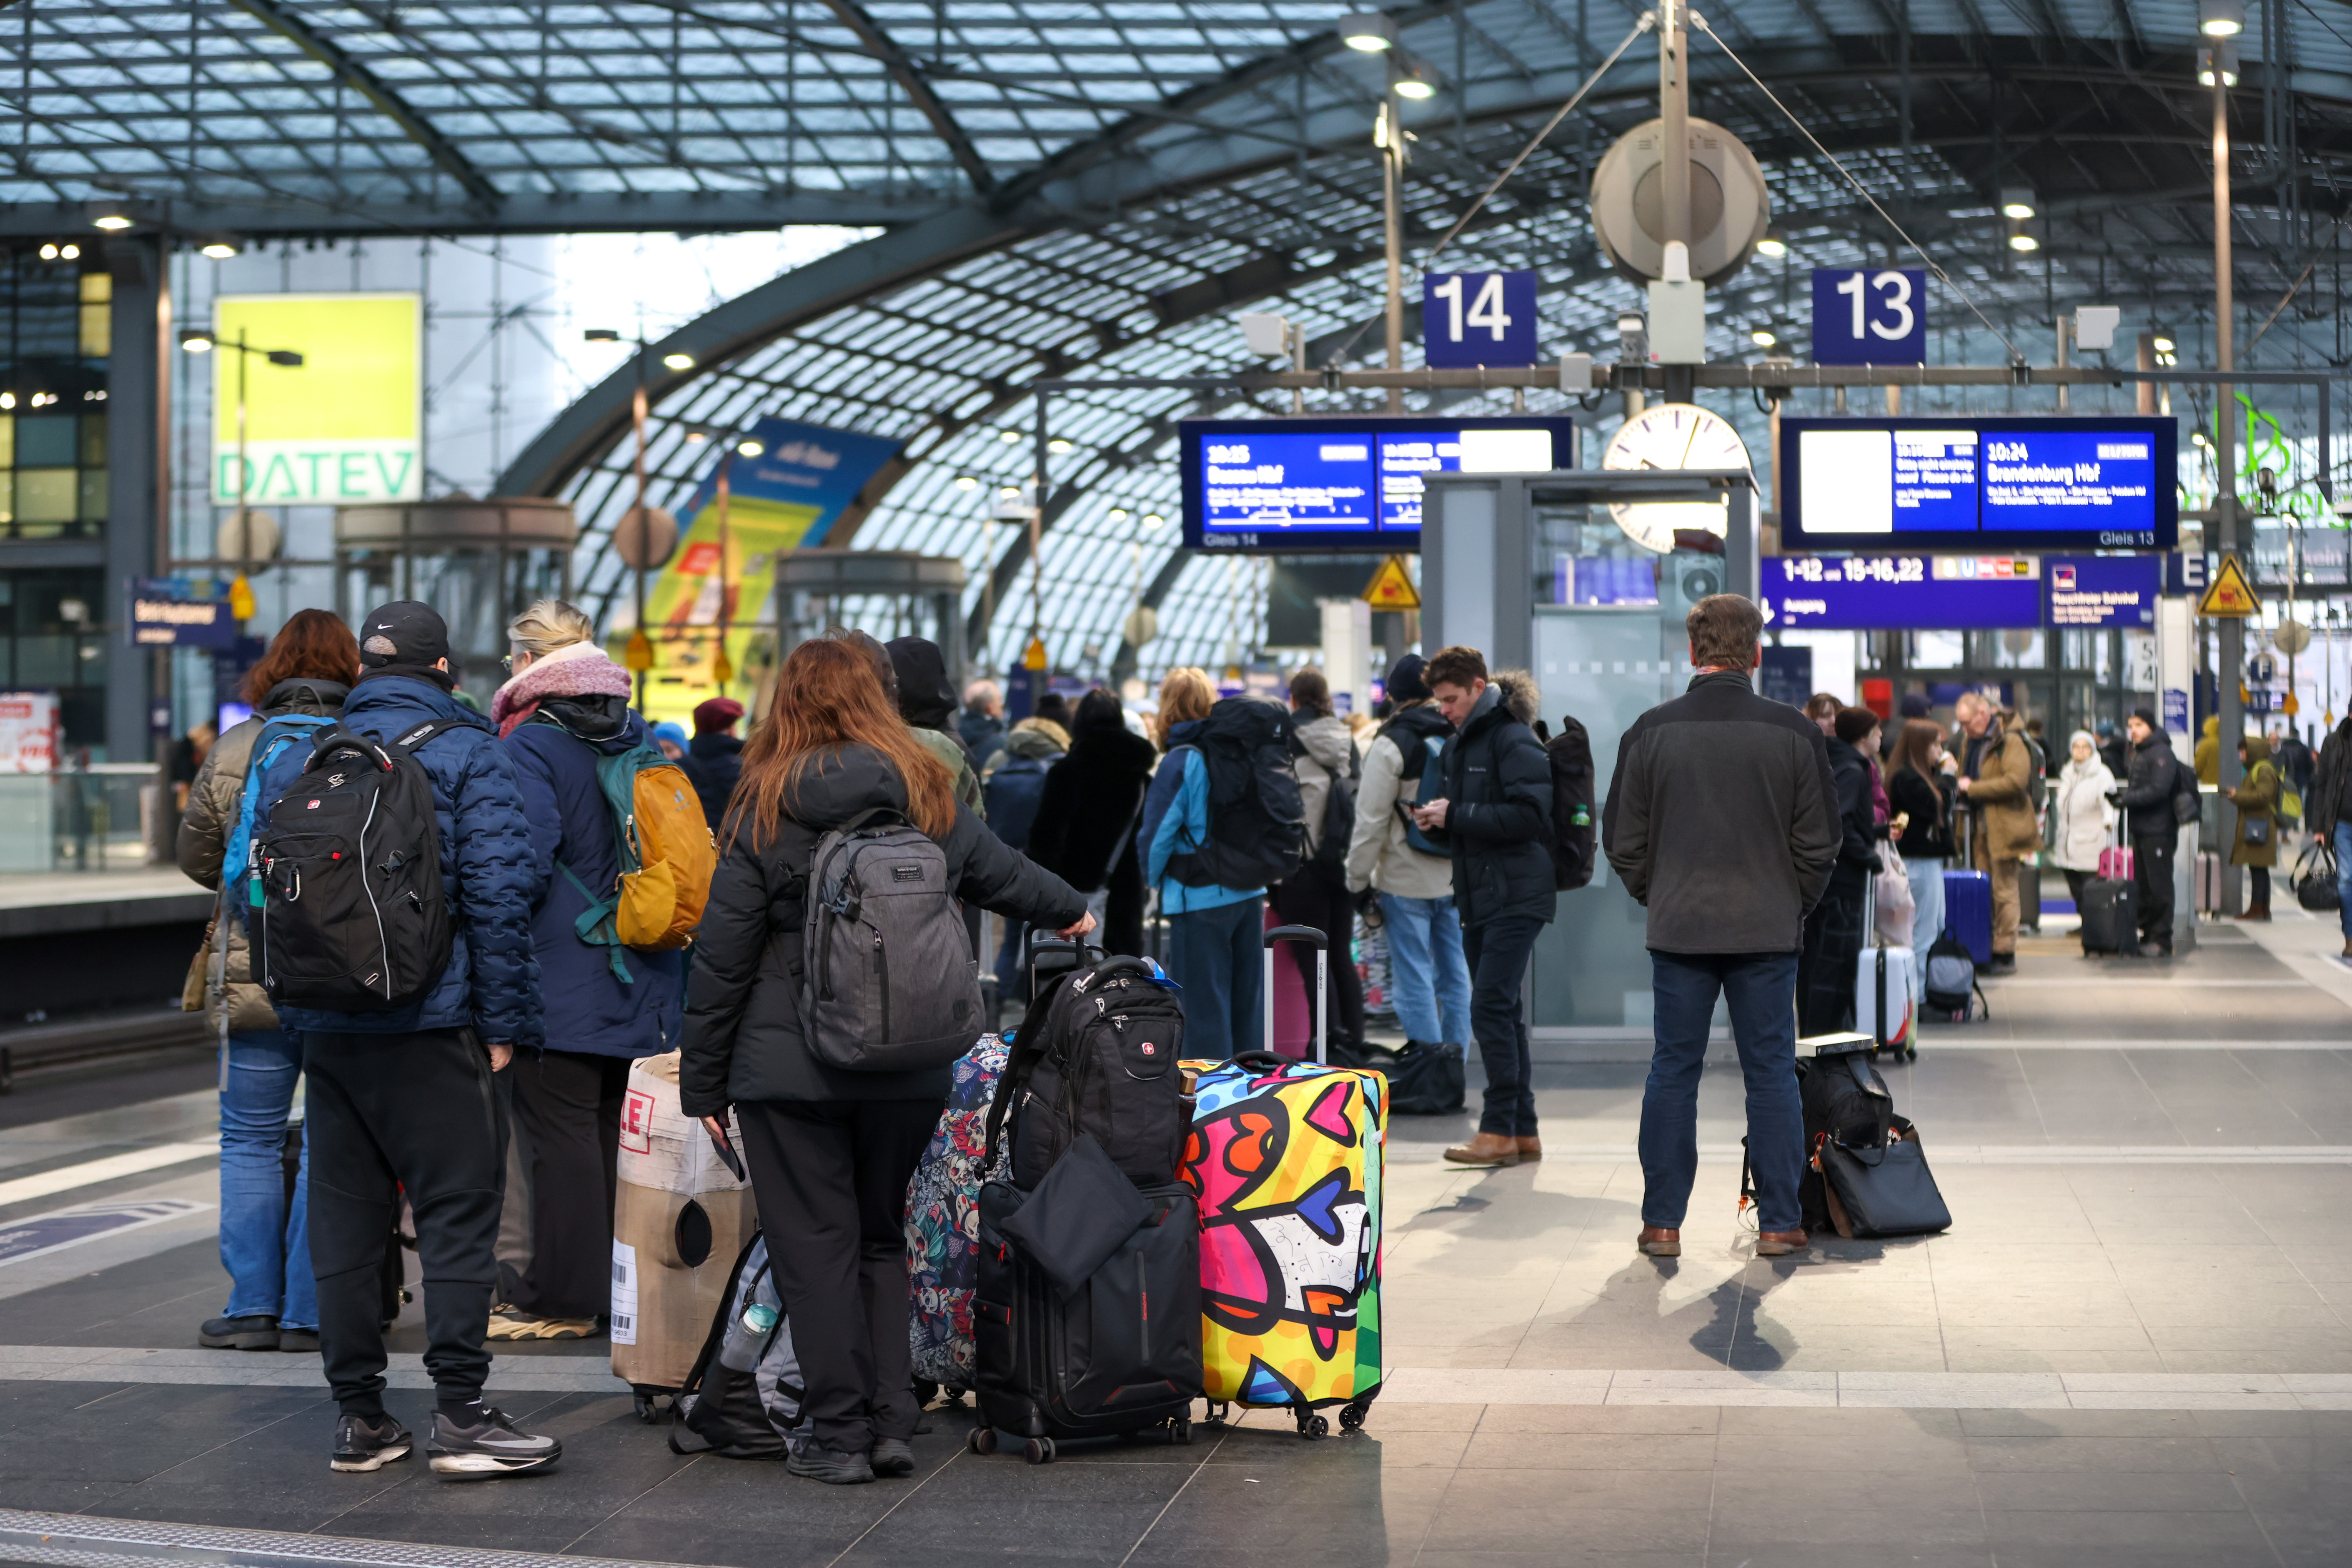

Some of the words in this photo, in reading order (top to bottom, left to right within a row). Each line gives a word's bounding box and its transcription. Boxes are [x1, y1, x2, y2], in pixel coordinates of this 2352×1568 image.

[1434, 274, 1512, 342] 14
[1837, 271, 1914, 340] 13
[1988, 442, 2029, 461] 10:24
[220, 451, 413, 498] DATEV
[1988, 463, 2073, 486] Brandenburg
[2075, 463, 2101, 482] Hbf
[1203, 534, 1238, 546] Gleis
[1242, 533, 1258, 546] 14
[2100, 531, 2134, 545] Gleis
[2139, 531, 2154, 545] 13
[1783, 559, 1823, 581] 1-12
[1842, 558, 1924, 584] 15-16,22
[1961, 559, 1975, 577] U
[2183, 551, 2204, 587] E
[1783, 597, 1826, 614] Ausgang
